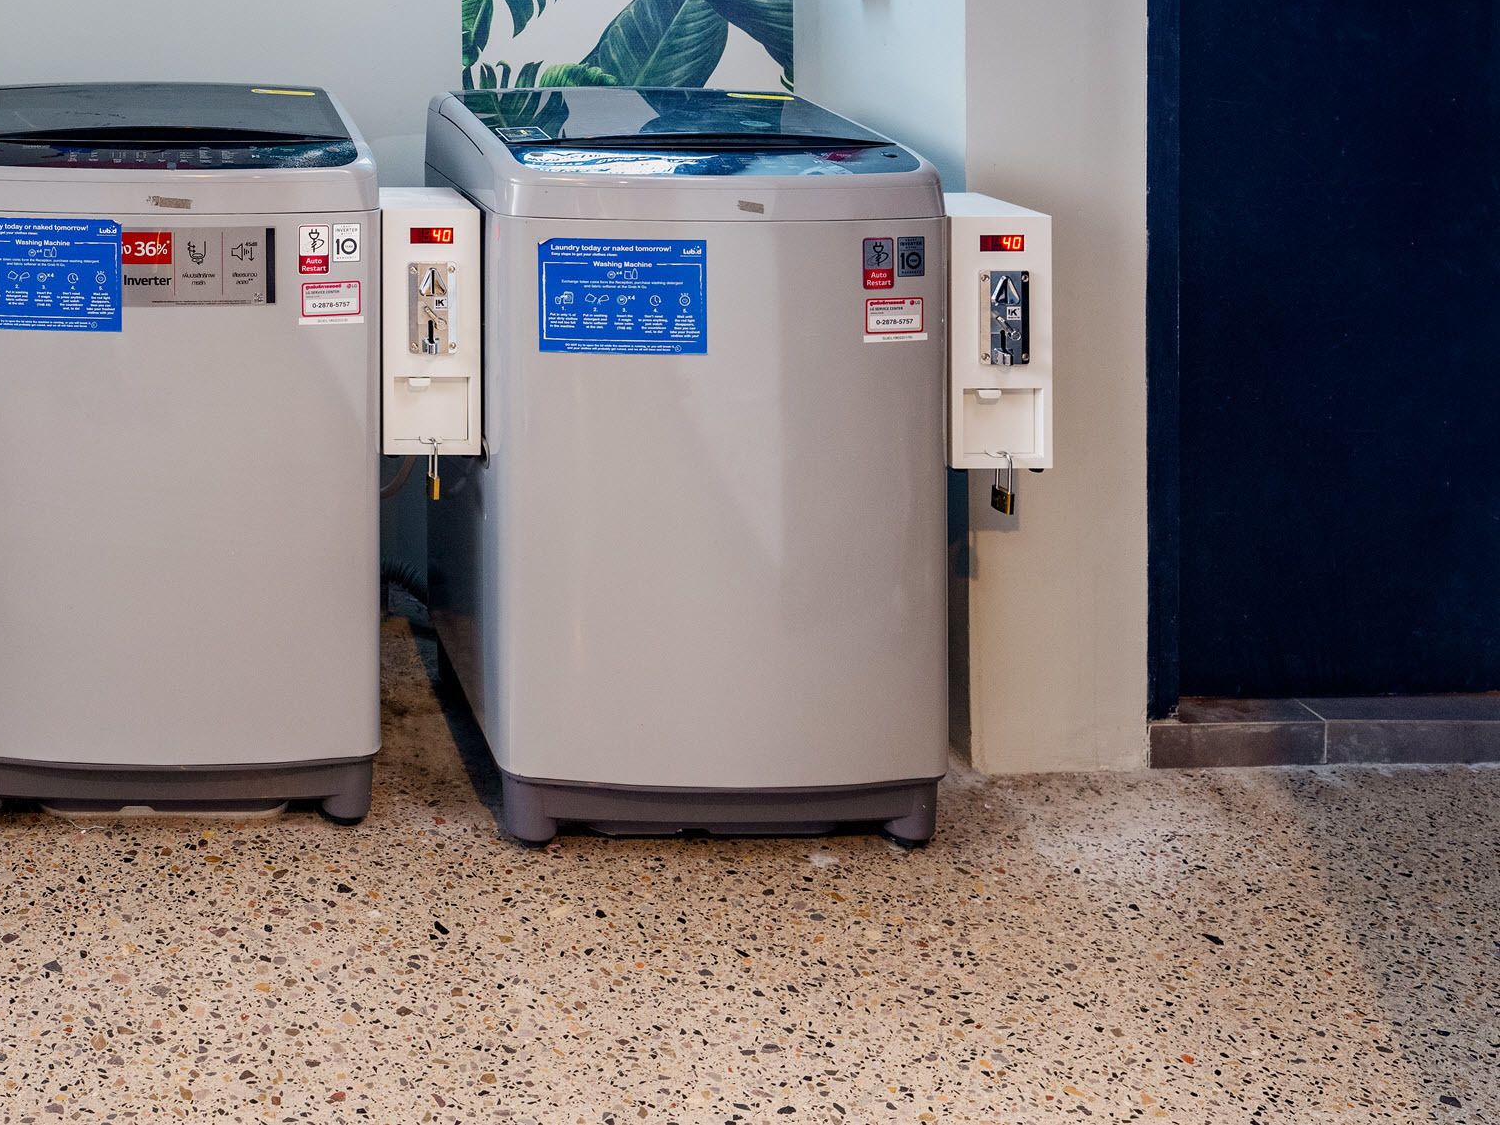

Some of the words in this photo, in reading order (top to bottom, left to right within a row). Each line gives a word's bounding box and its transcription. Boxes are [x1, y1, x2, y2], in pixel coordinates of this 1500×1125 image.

[4, 223, 23, 231] today
[433, 230, 451, 242] 40
[15, 239, 43, 247] Washing
[1002, 237, 1021, 250] 40
[550, 244, 580, 252] Laundry
[124, 275, 172, 286] Inverter
